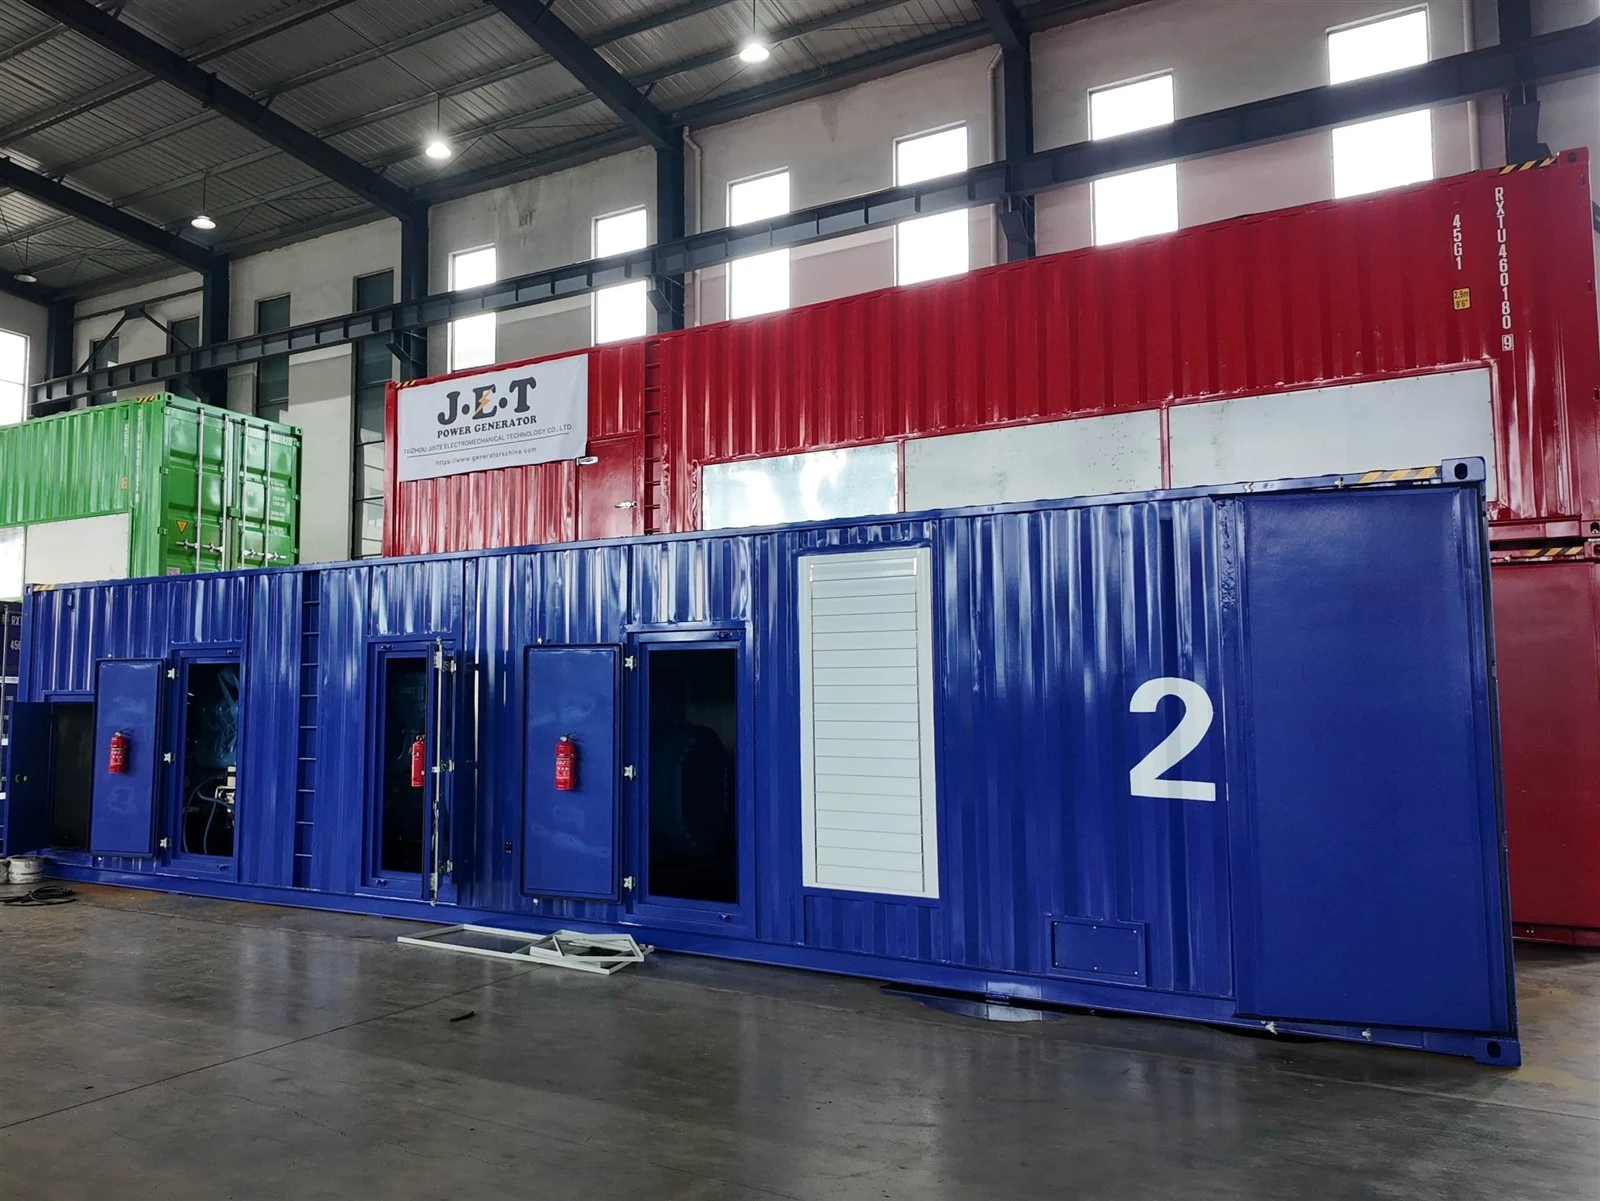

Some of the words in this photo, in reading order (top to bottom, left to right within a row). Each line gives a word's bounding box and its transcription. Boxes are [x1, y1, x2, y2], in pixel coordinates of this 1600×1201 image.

[1452, 213, 1463, 270] 45G1
[1503, 335, 1513, 350] 9
[437, 425, 472, 438] POWER
[474, 415, 537, 433] GENERATOR
[403, 446, 427, 454] TAIZHOU
[444, 435, 505, 450] ELECTROMECHANICAL
[506, 428, 547, 440] TECHNOLOGY
[11, 615, 21, 626] RX
[1129, 677, 1216, 801] 2
